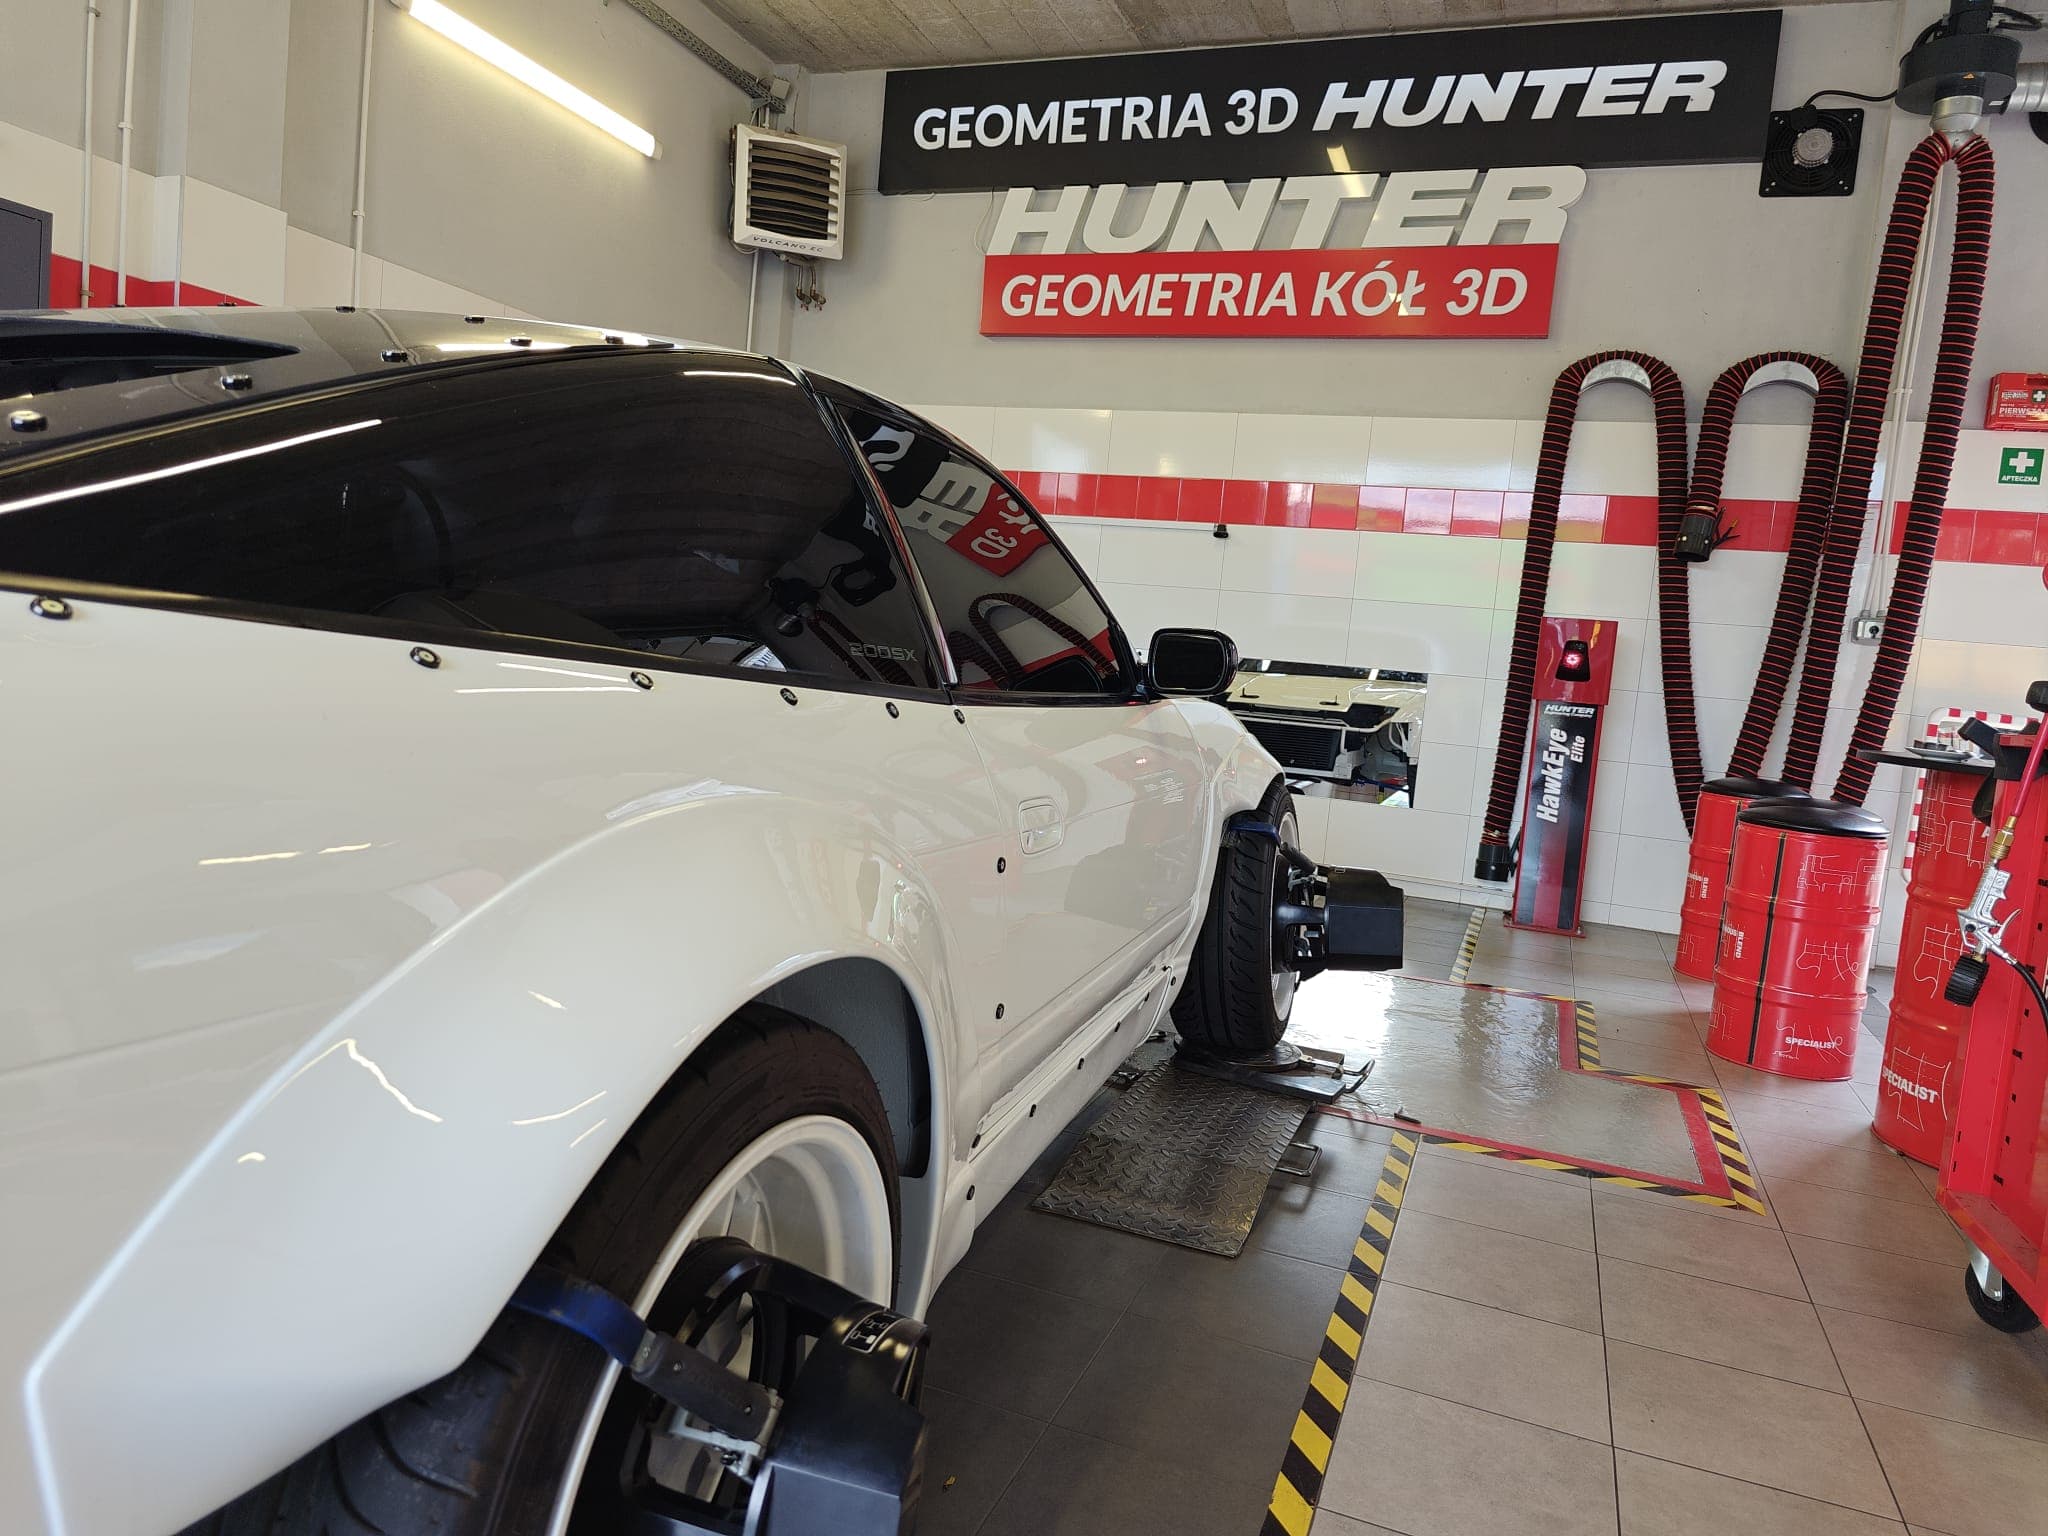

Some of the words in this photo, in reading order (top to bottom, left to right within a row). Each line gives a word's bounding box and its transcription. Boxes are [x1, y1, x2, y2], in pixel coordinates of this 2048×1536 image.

[913, 92, 1212, 151] GEOMETRIA
[1224, 87, 1299, 136] 3D
[1312, 60, 1727, 132] HUNTER
[988, 165, 1587, 255] HUNTER
[753, 235, 807, 250] VOLCANO
[1000, 272, 1299, 319] GEOMETRIA
[1310, 260, 1427, 318] KÓŁ
[1446, 267, 1529, 318] 3D
[2001, 475, 2038, 483] APTECZKA
[849, 642, 918, 662] 200SX
[1544, 704, 1596, 716] HUNTER
[1570, 735, 1586, 763] Elite
[1535, 727, 1571, 824] HawkEye
[1735, 931, 1745, 959] BLEND
[1785, 1036, 1837, 1050] SPECIALIST
[1881, 1066, 1940, 1104] SPECIALIST
